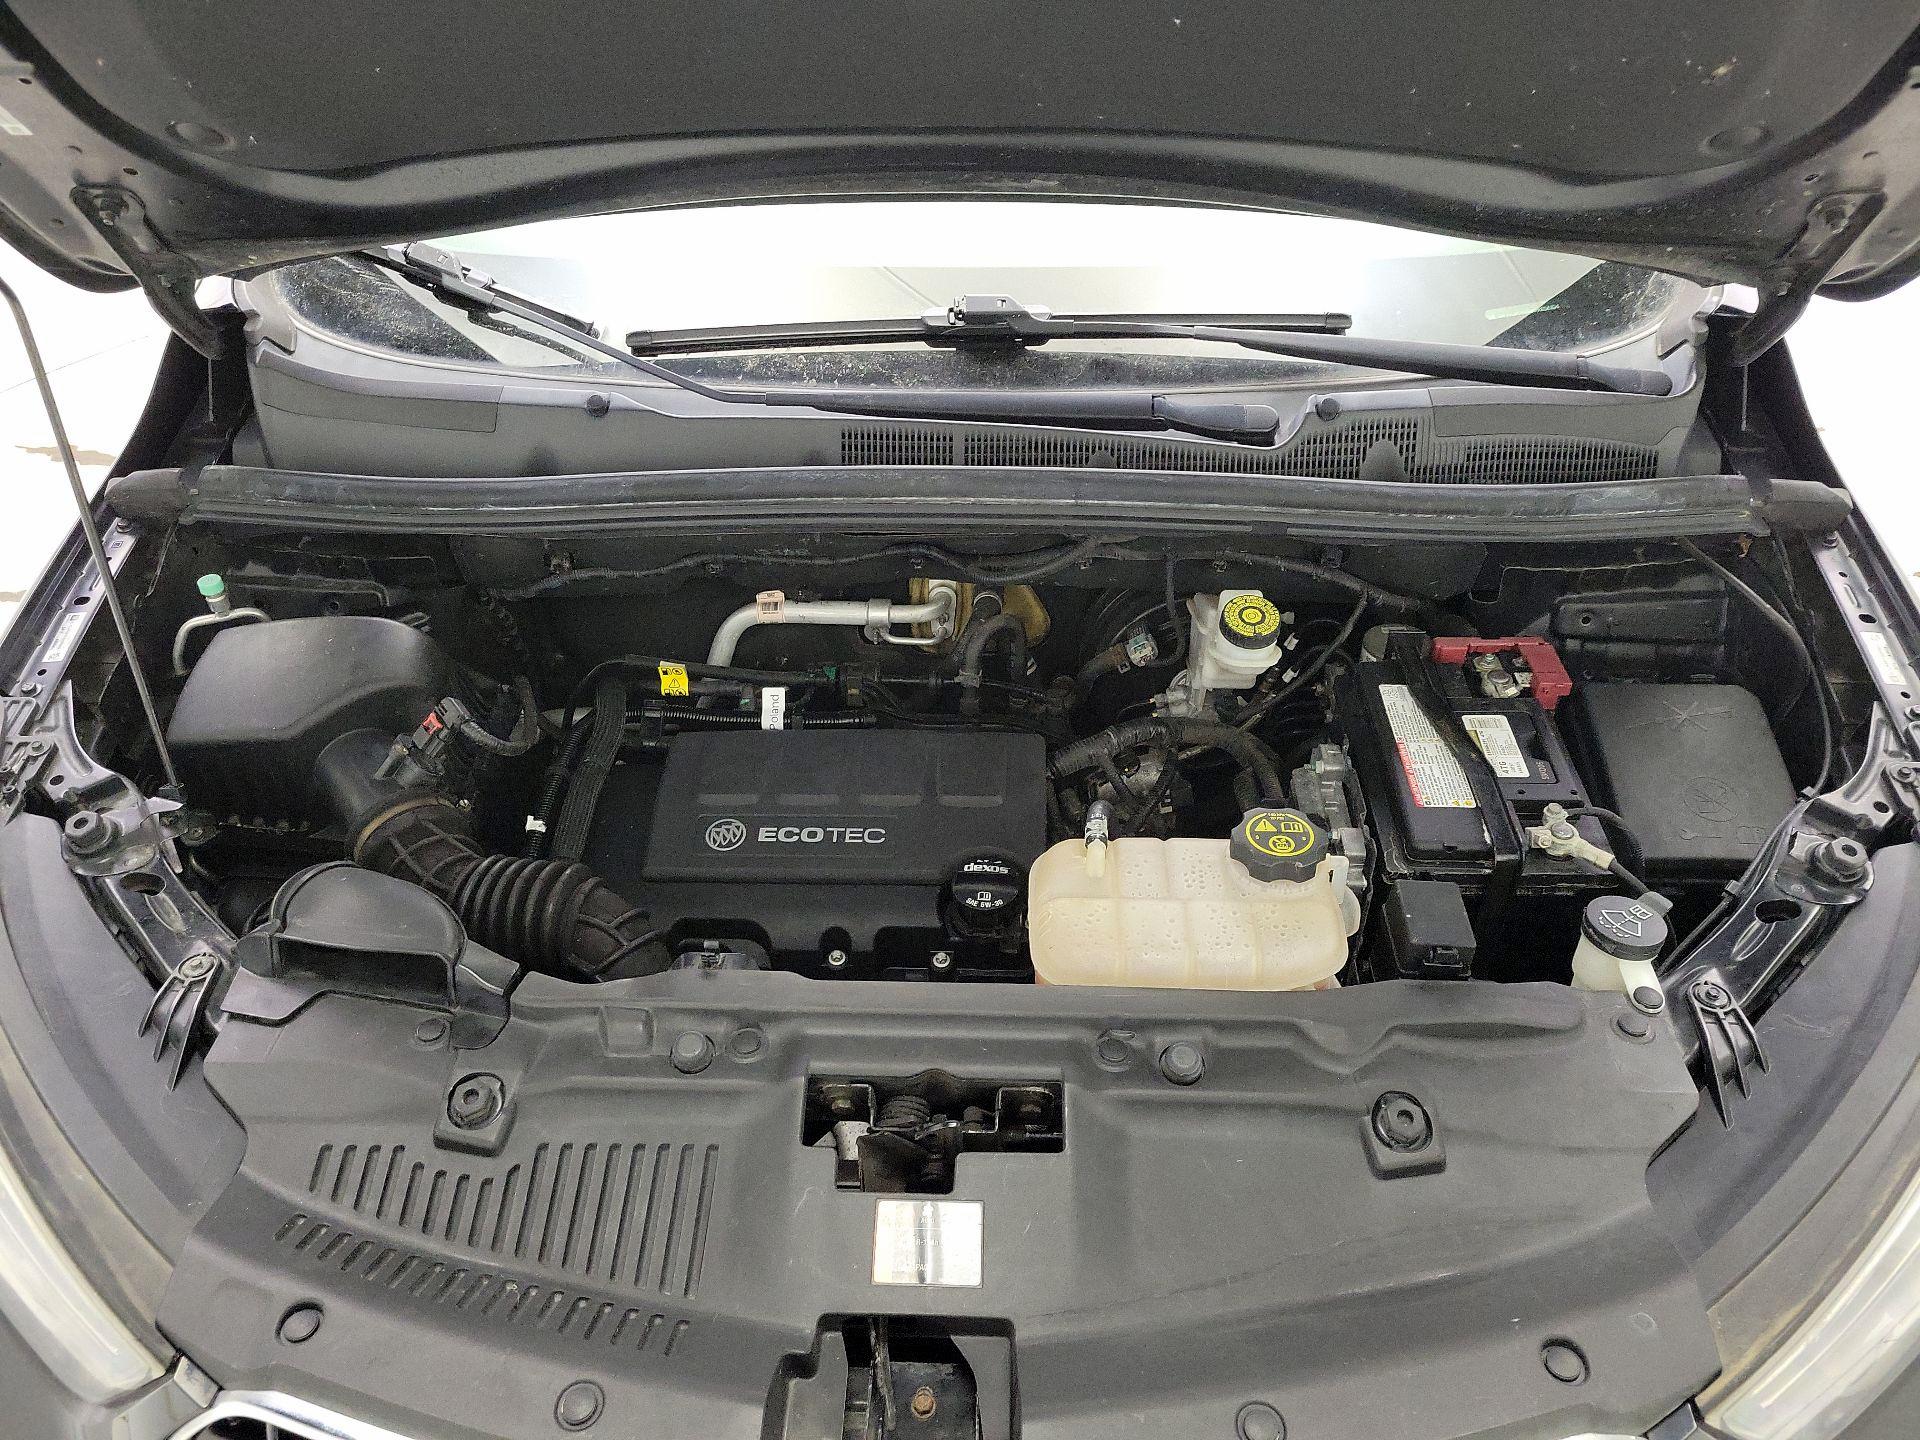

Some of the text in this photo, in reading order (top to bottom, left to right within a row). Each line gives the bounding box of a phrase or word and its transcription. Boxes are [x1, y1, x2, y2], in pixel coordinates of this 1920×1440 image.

[757, 826, 887, 844] ECOTEC
[963, 862, 1009, 874] dexos
[965, 897, 979, 907] SAE
